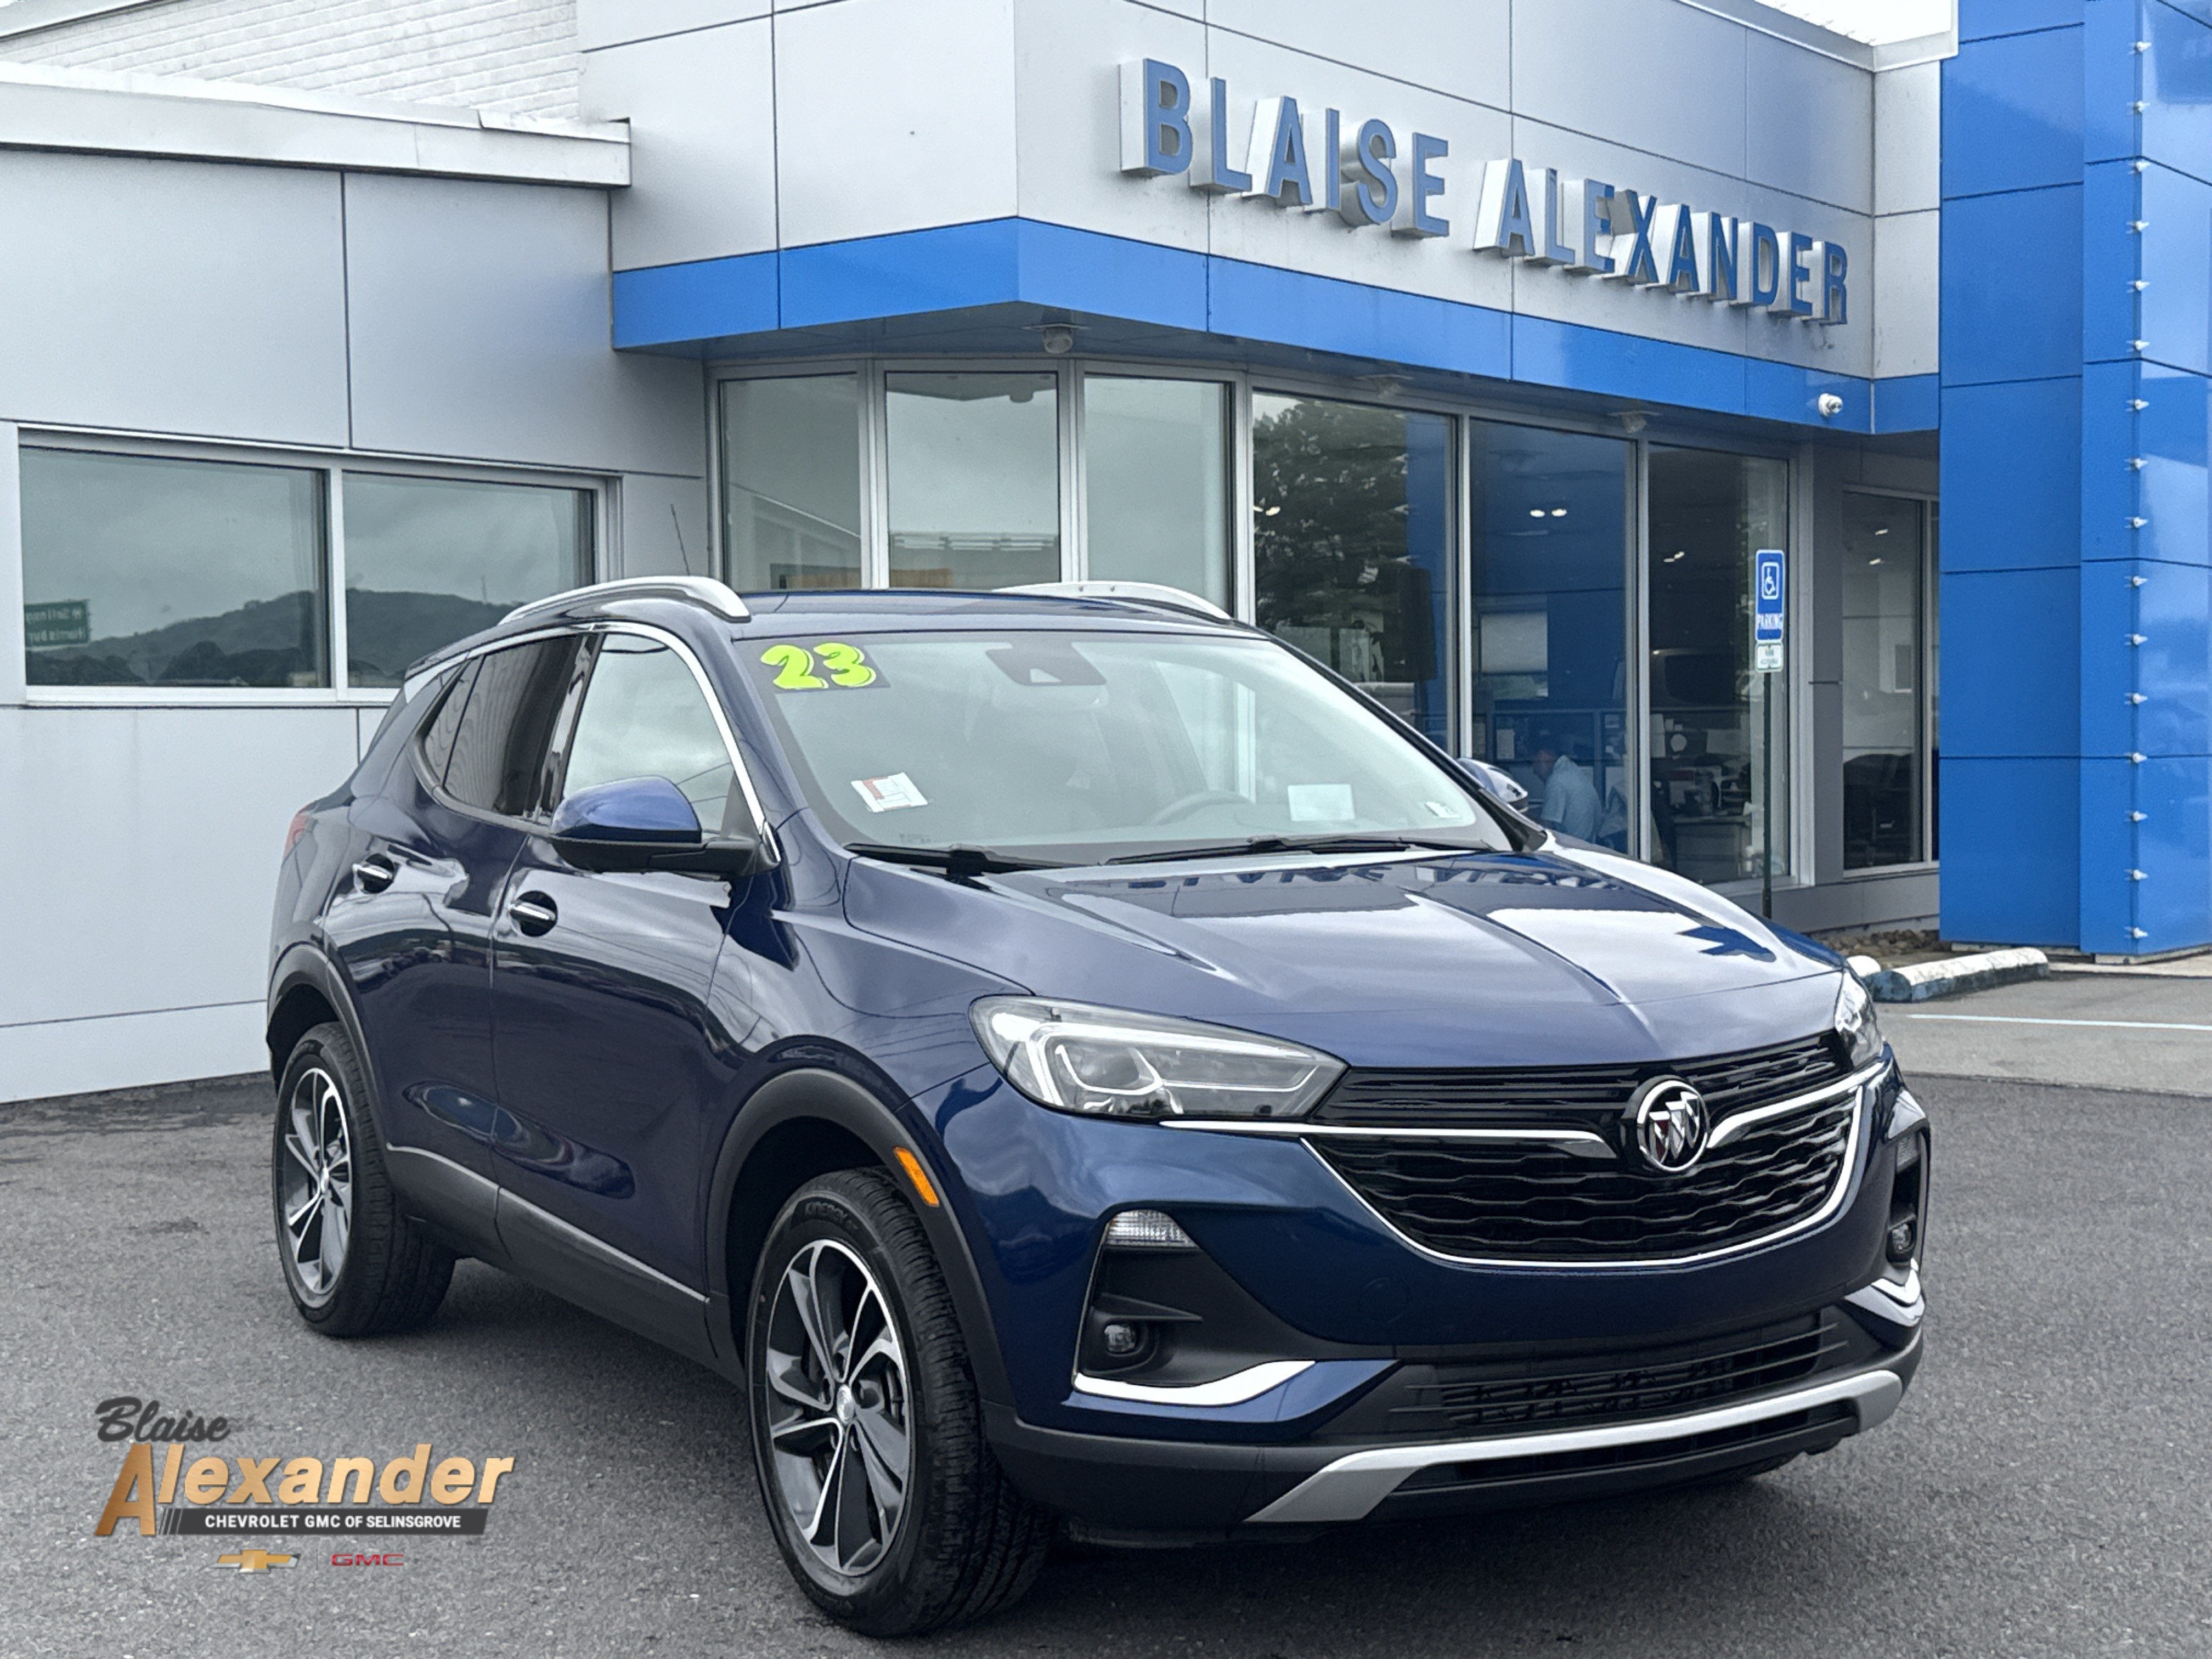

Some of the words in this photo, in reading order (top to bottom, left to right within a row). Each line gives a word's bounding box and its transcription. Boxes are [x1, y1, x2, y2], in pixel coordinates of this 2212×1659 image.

[1119, 57, 1449, 239] BLAISE
[1473, 159, 1848, 325] ALEXANDER
[760, 642, 877, 690] 23
